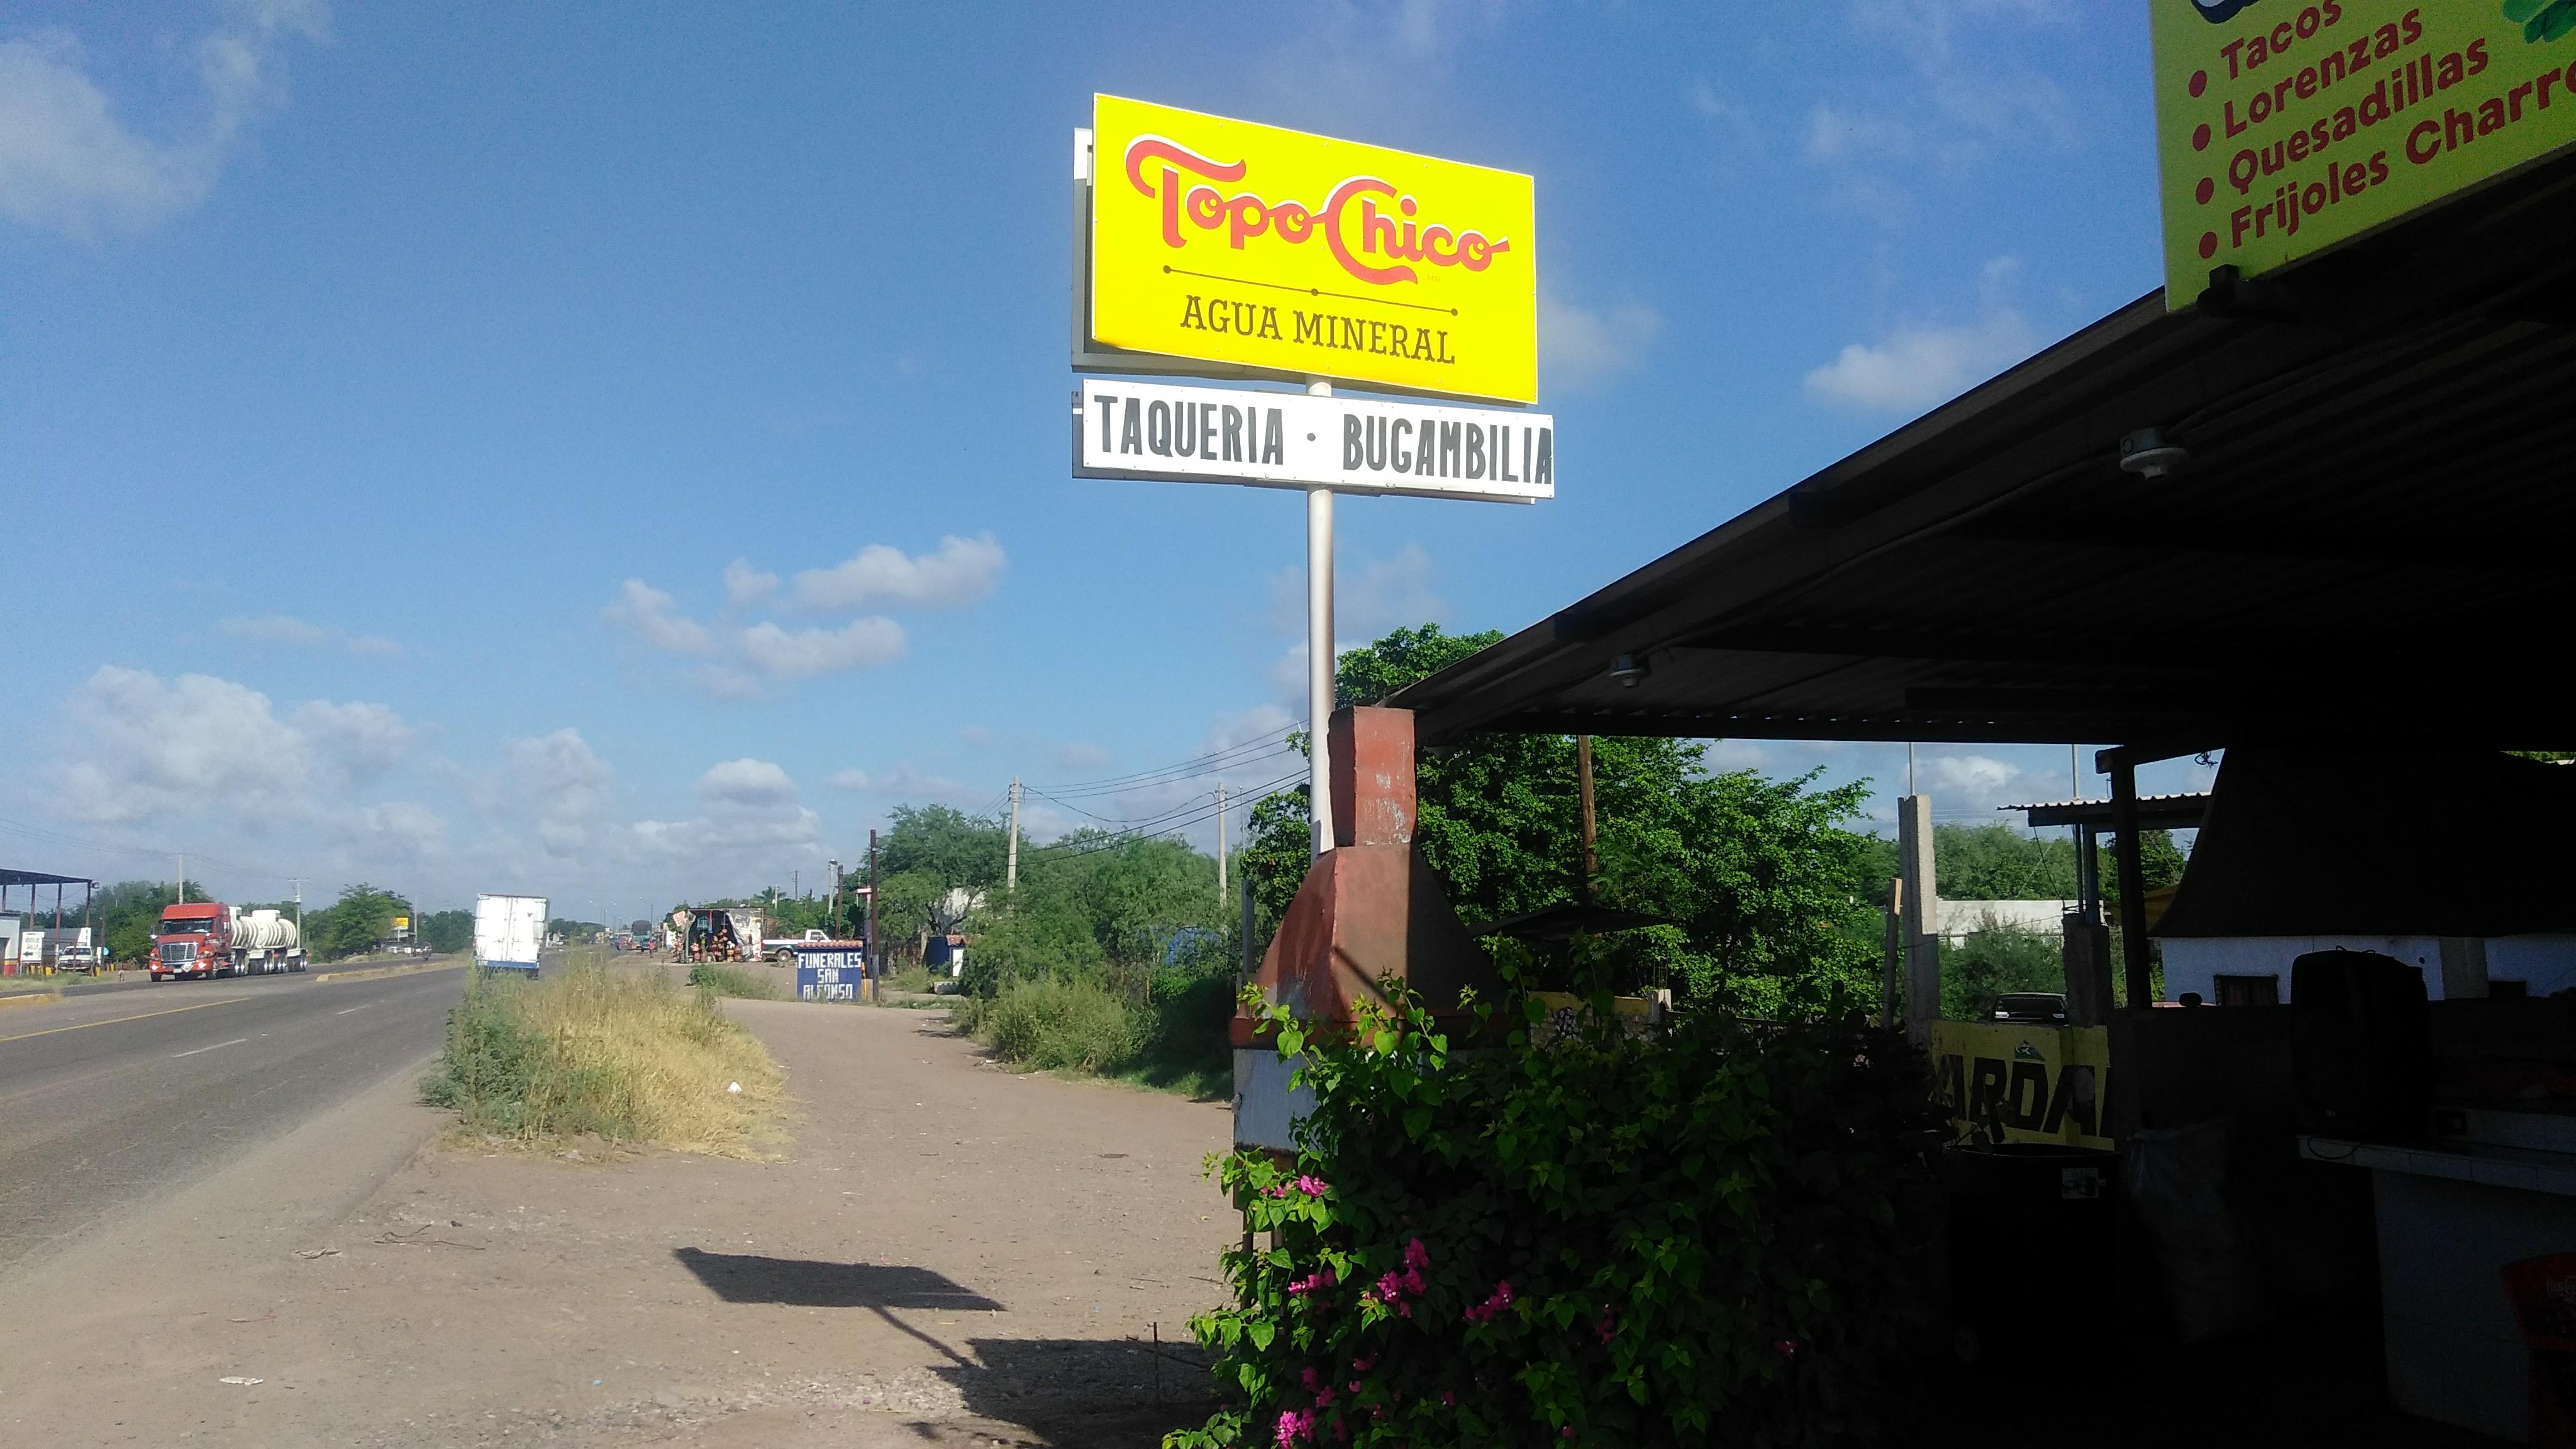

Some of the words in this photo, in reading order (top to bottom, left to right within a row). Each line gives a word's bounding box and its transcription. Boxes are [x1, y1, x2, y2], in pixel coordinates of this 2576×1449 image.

[2220, 0, 2342, 80] Tacos
[2224, 9, 2423, 140] Lorenzas
[2228, 37, 2489, 196] Quesadillas
[1124, 133, 1319, 249] Topo
[1323, 175, 1510, 286] Chico
[2231, 150, 2389, 248] Frijoles
[1180, 295, 1283, 341] AGUA
[1293, 310, 1456, 365] MINERAL
[1094, 394, 1284, 466] TAQUERIA
[1343, 413, 1552, 485] BUGAMBILIA
[798, 952, 862, 969] FUNERALES
[817, 968, 839, 984] SAN
